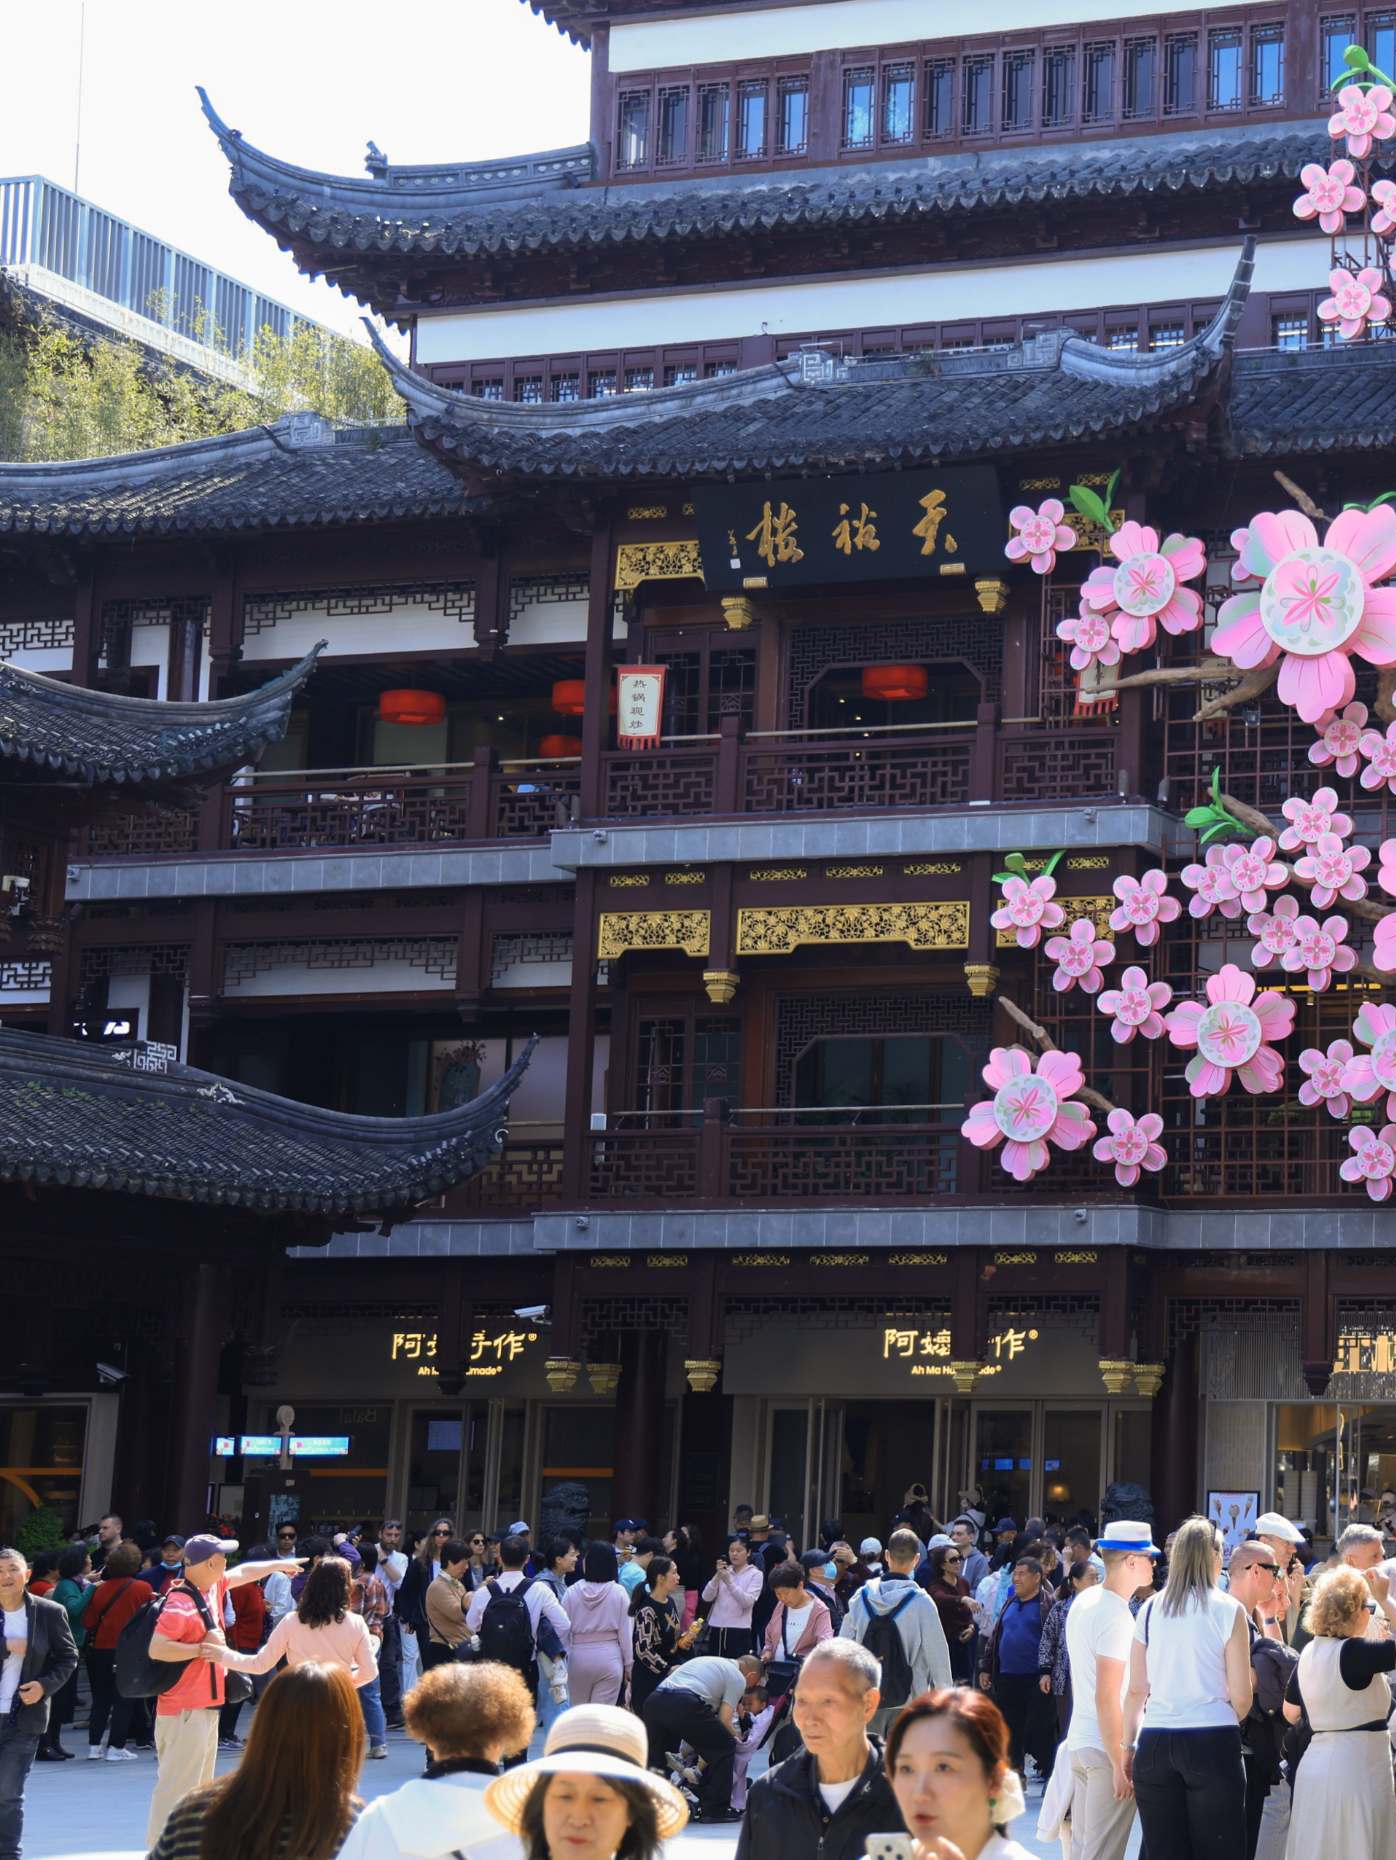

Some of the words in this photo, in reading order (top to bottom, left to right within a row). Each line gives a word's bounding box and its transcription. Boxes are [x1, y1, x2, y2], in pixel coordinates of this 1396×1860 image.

[391, 1330, 526, 1361] 阿手作
[911, 1365, 925, 1375] Ah
[926, 1365, 941, 1375] Ma
